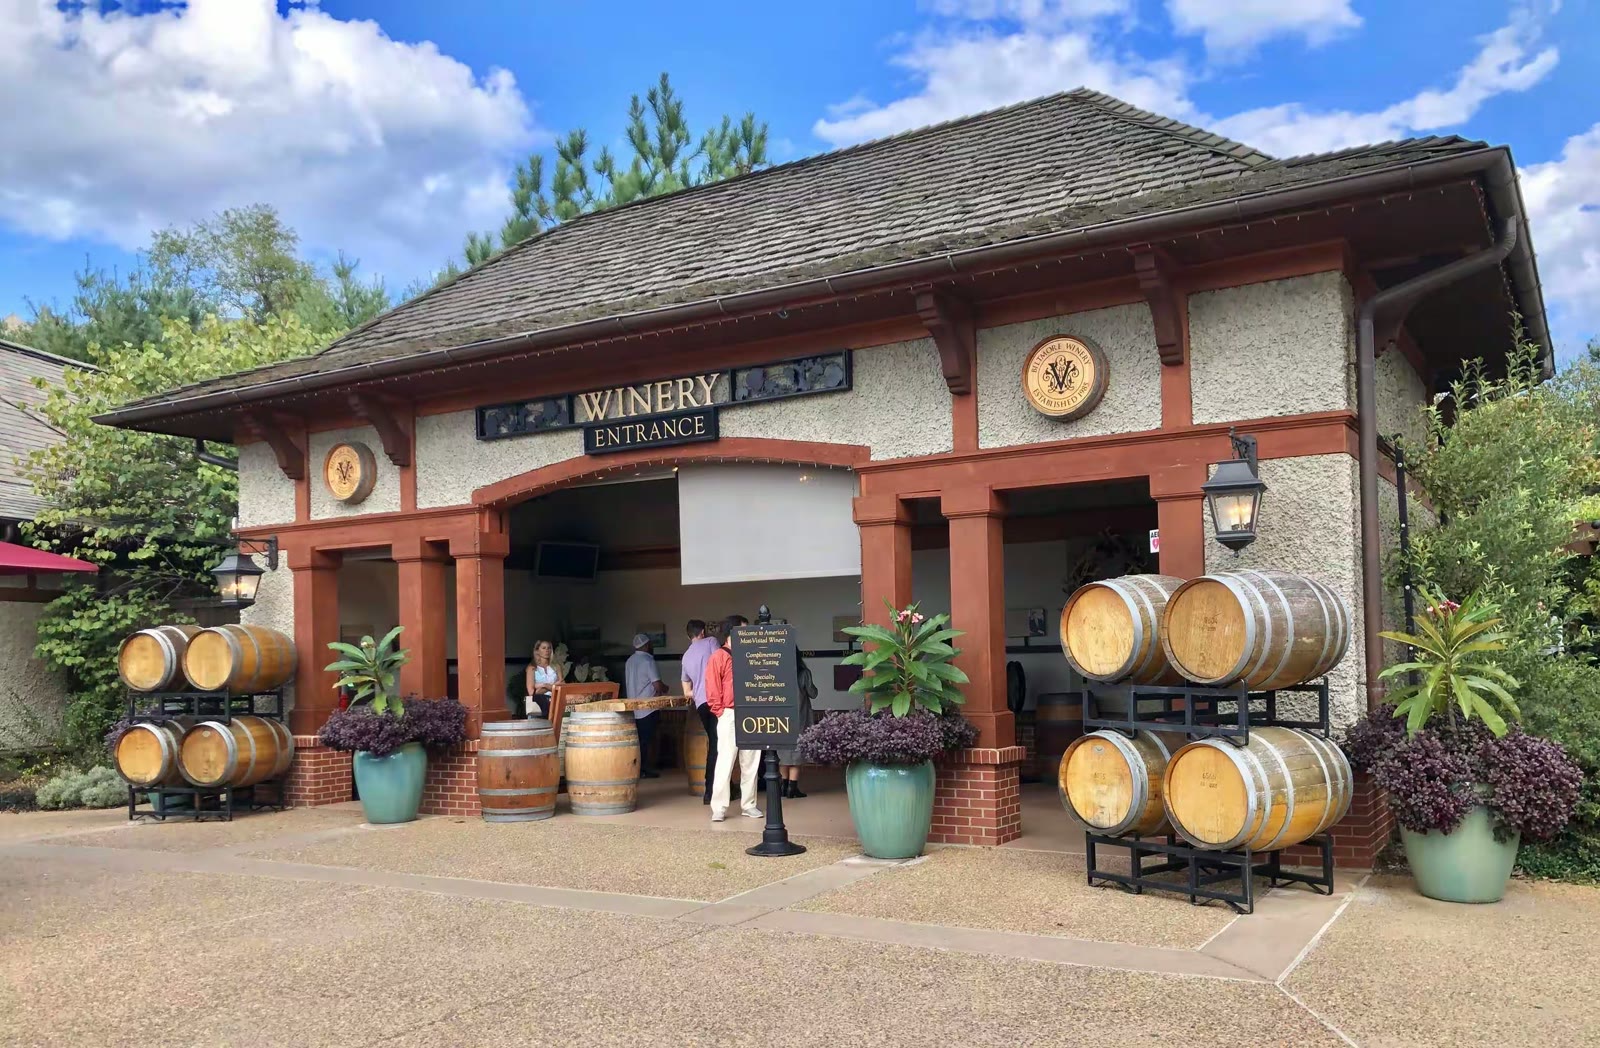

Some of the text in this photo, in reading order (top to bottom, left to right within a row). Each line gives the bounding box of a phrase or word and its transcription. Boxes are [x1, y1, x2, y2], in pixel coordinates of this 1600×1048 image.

[1031, 342, 1091, 373] BILTMORE WINERY
[578, 372, 720, 422] WINERY
[1033, 388, 1078, 408] ESTABLISHED
[595, 415, 706, 448] ENTRANCE
[768, 636, 786, 644] Winery
[745, 651, 782, 659] Complimentary
[774, 695, 787, 703] Shop
[742, 716, 790, 734] OPEN
